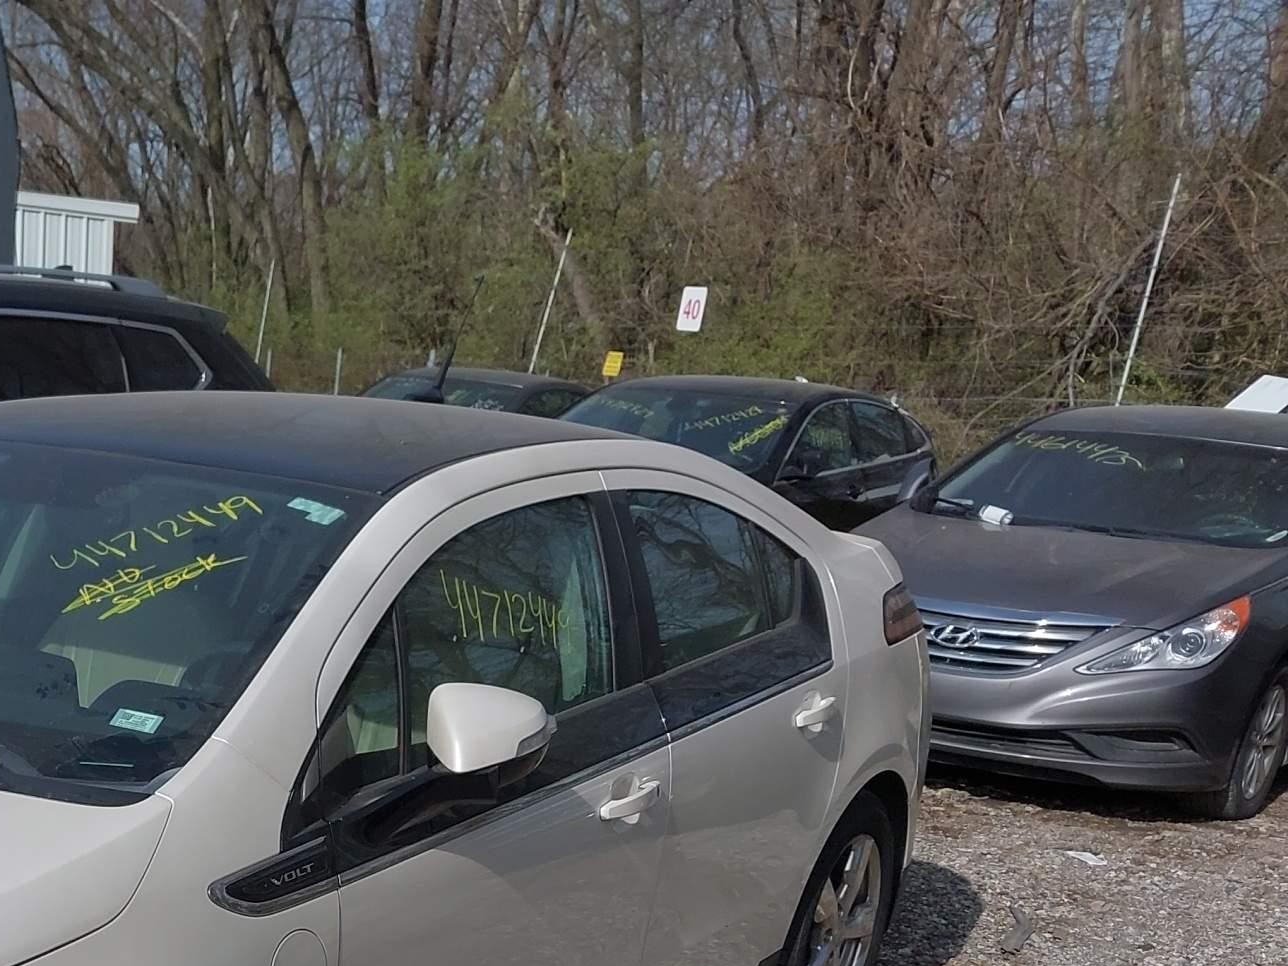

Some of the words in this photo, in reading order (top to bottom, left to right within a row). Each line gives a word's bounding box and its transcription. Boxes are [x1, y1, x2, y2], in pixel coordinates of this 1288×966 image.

[683, 299, 701, 320] 40
[50, 495, 264, 569] 44712449
[271, 862, 314, 886] VOLT
